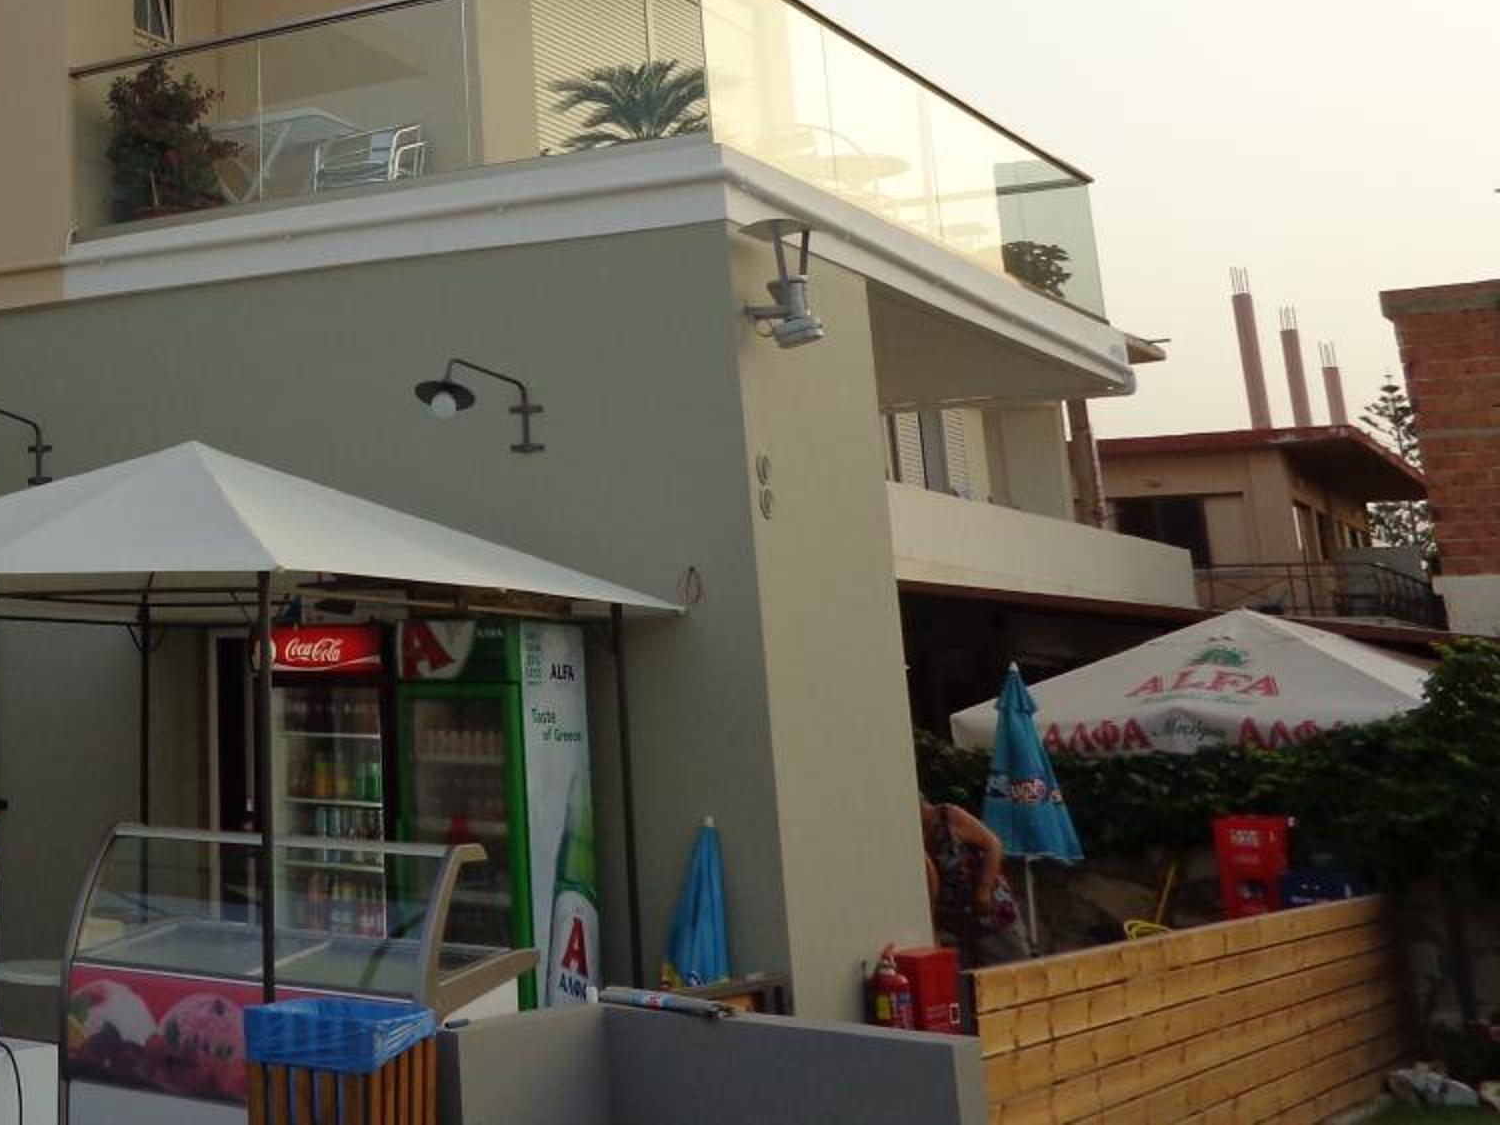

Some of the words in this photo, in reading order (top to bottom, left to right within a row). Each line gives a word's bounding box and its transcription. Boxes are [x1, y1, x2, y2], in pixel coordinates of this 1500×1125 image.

[285, 638, 341, 663] Coca-Cola
[549, 662, 575, 682] ALFA
[1124, 667, 1280, 698] ALFA
[531, 707, 556, 724] Taste
[554, 728, 582, 742] Greece
